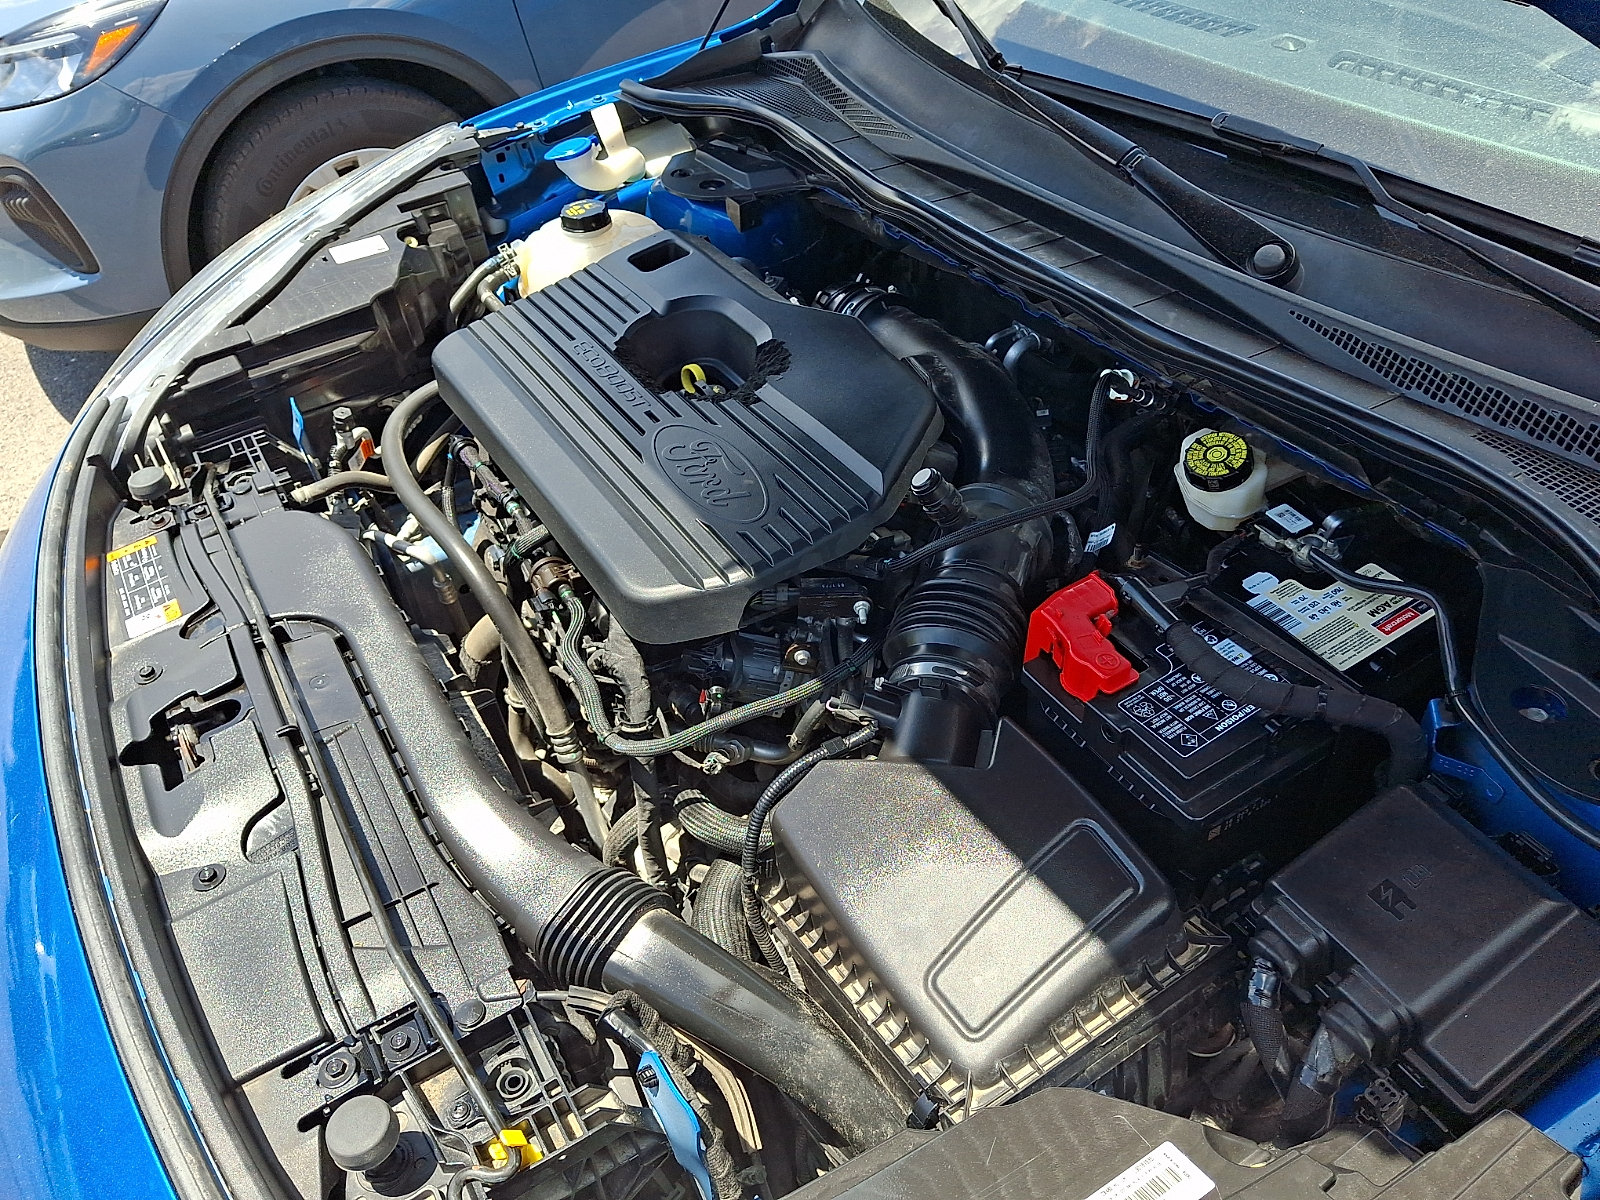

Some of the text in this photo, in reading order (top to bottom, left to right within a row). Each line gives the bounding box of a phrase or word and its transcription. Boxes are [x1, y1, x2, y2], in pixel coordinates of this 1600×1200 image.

[255, 121, 336, 198] Continental
[662, 440, 752, 507] Ford
[1366, 600, 1391, 618] AGM
[1382, 611, 1415, 632] Motorcraft
[1156, 690, 1168, 698] NOT
[1214, 703, 1255, 732] ER/POISON
